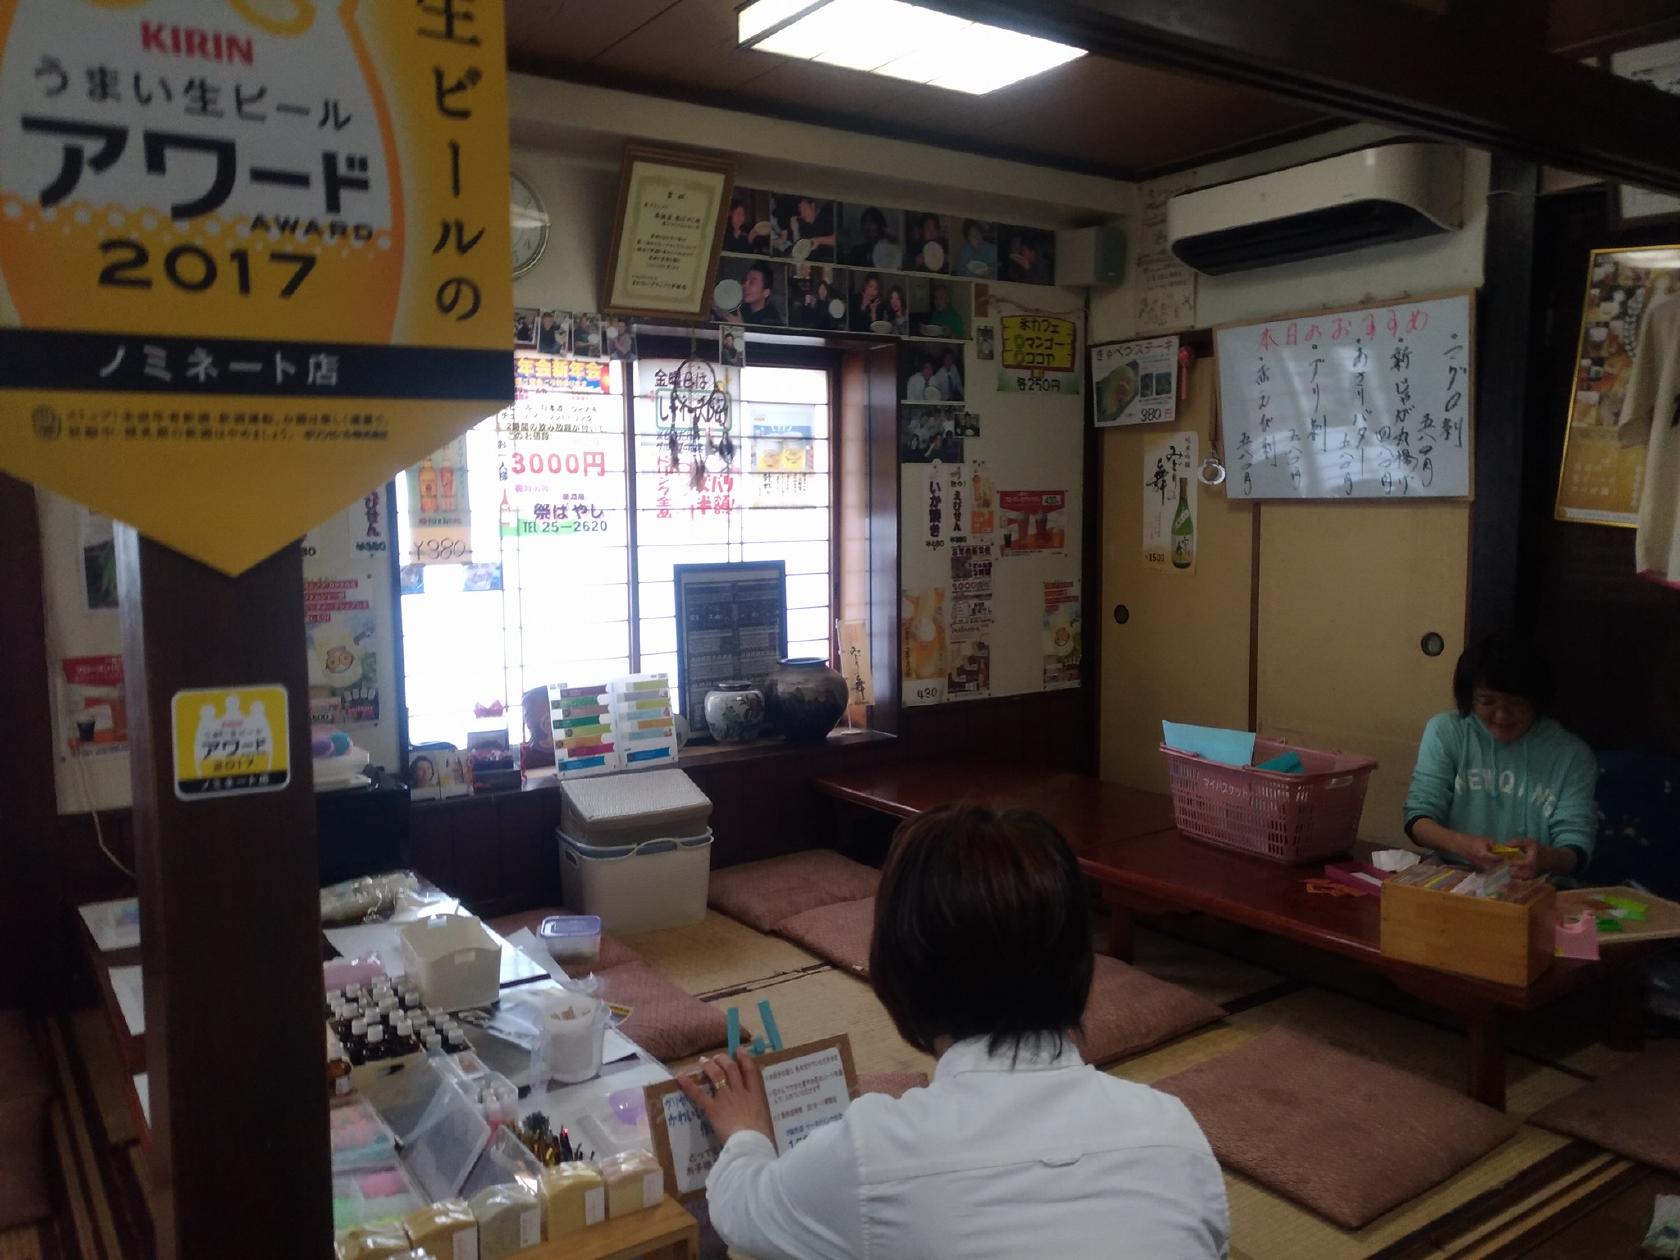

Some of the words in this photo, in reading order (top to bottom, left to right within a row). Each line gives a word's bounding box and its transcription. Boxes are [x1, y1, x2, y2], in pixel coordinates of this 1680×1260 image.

[140, 20, 255, 65] KIRIN
[34, 54, 351, 131] うまい生ビール
[20, 115, 370, 220] アワード
[249, 213, 374, 242] AWARD
[98, 237, 317, 299] 2017
[1026, 337, 1066, 350] マンゴー
[1261, 309, 1429, 351] 本日のおすすめ
[100, 345, 339, 387] ノミネート店
[511, 450, 607, 477] 3000円
[523, 521, 538, 534] TEL
[533, 502, 605, 521] 祭はやし
